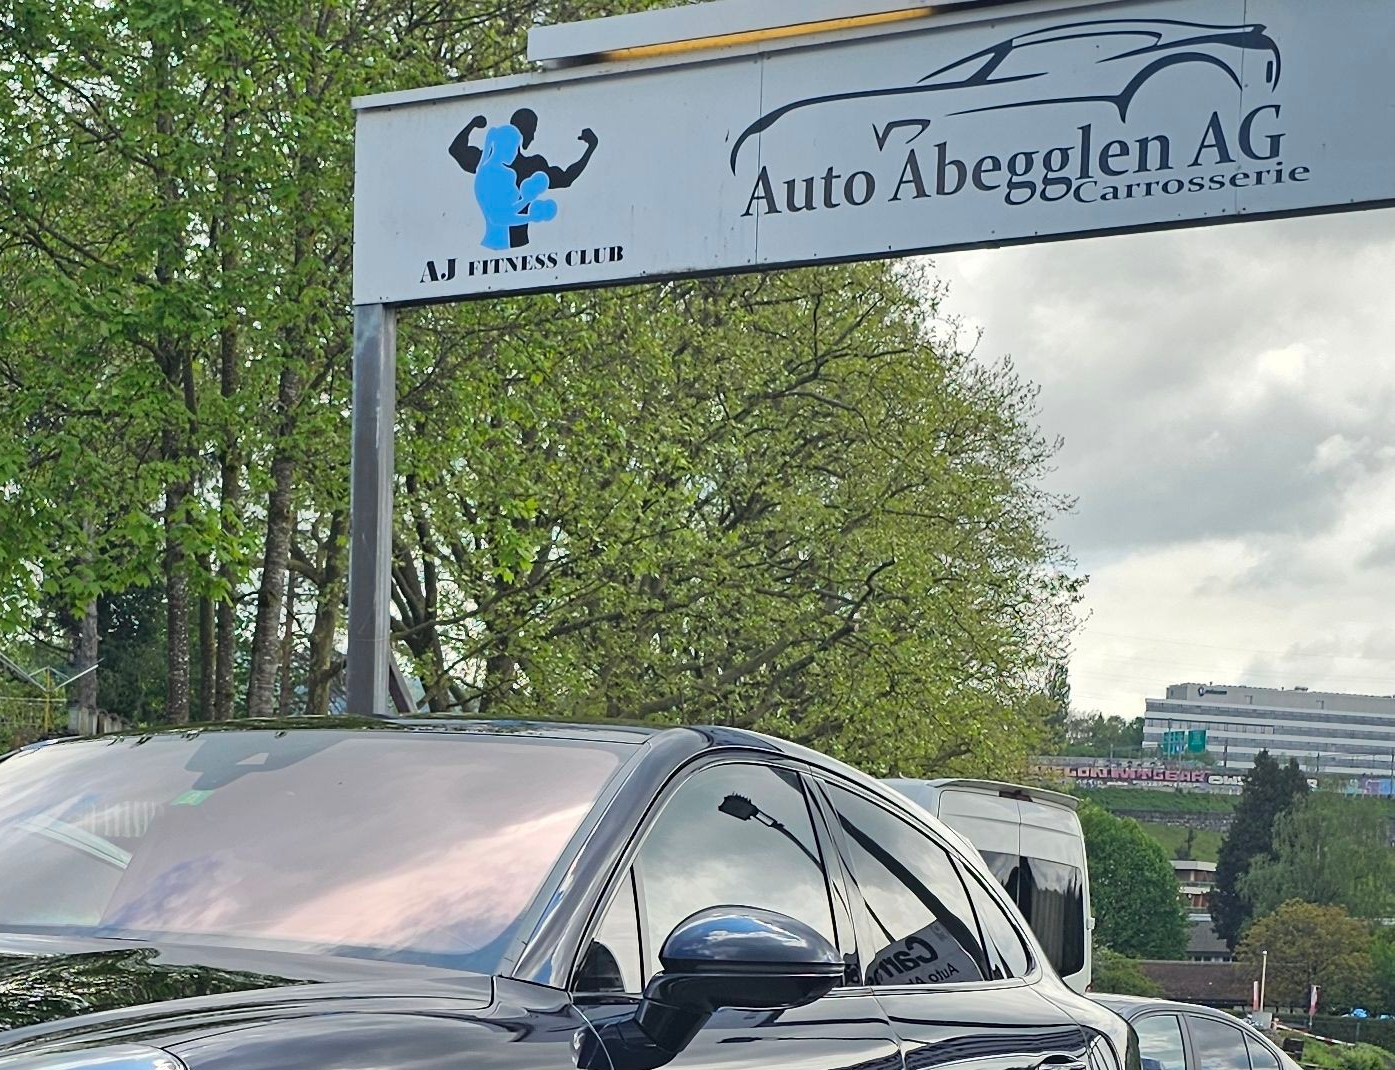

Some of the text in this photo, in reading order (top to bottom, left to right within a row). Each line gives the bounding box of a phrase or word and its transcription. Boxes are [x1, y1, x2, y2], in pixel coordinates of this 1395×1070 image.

[740, 104, 1286, 218] Auto Abegglen AG
[1072, 161, 1311, 203] Carrosserie
[419, 245, 624, 284] AJ FITNESS CLUB
